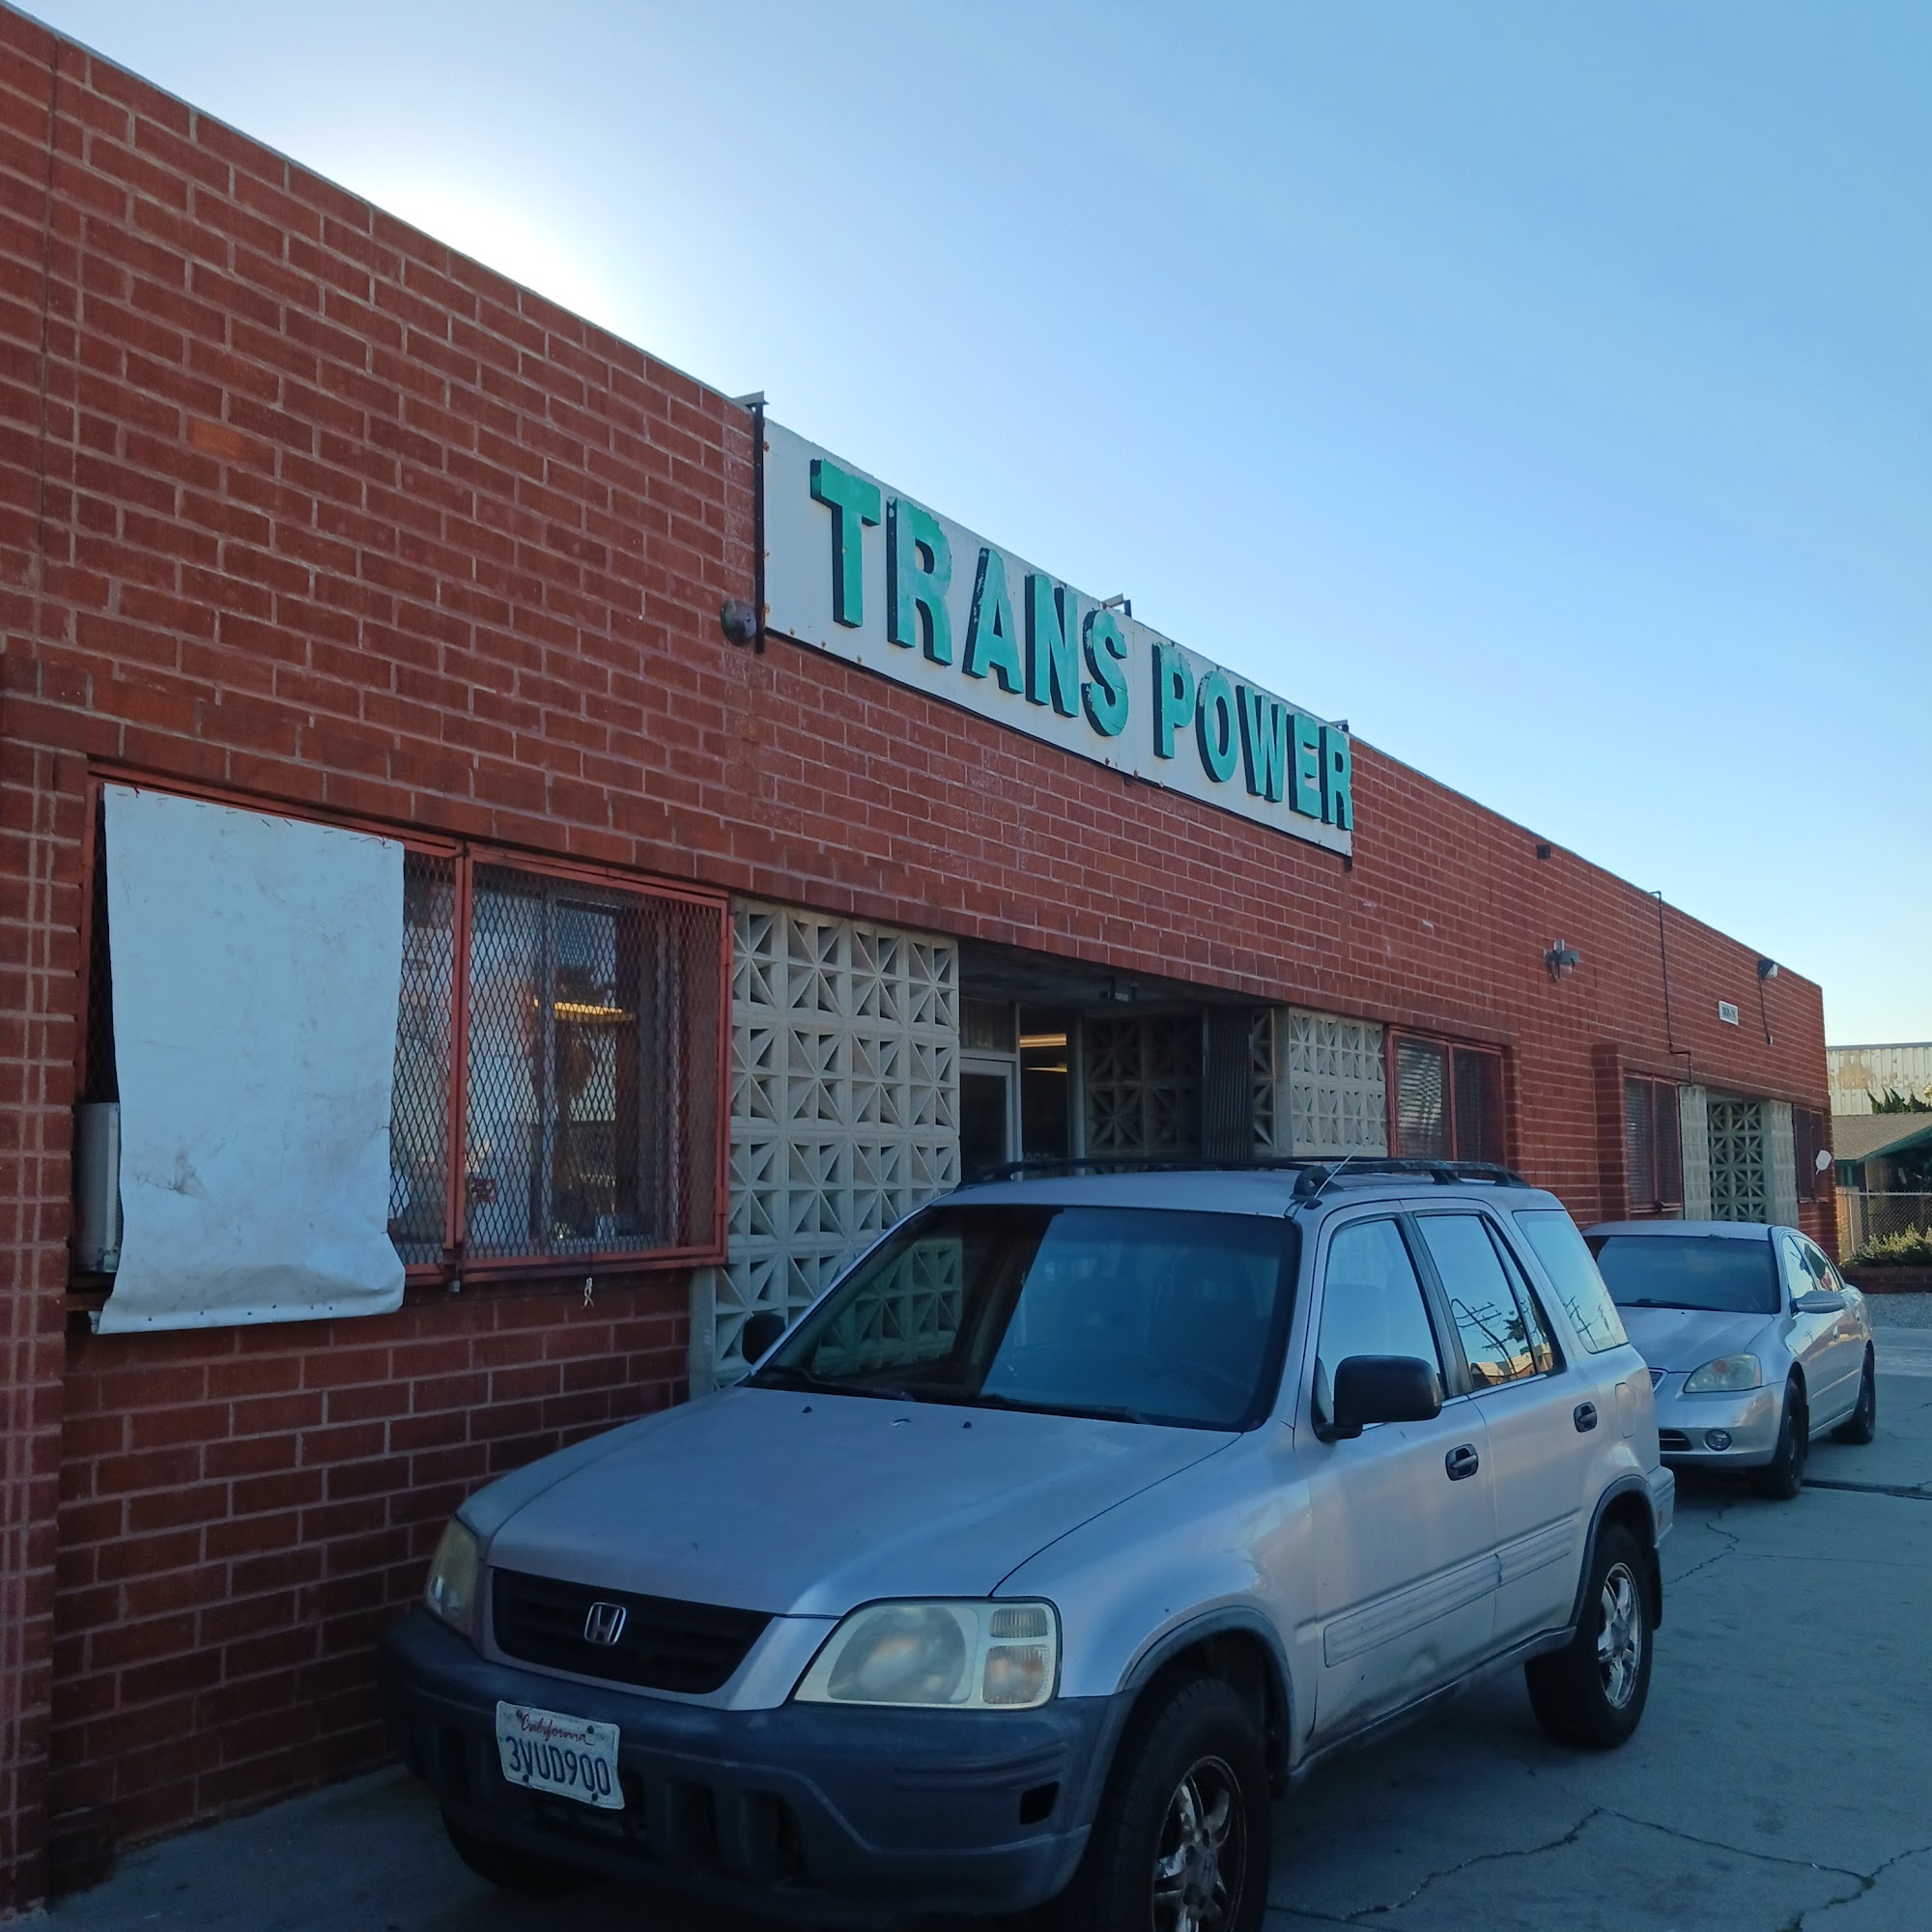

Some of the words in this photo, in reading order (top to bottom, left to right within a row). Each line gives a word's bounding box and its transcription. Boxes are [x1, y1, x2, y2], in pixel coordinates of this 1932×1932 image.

[810, 459, 1129, 737] TRANS
[1151, 640, 1354, 832] POWER
[521, 1713, 595, 1746] California
[505, 1735, 611, 1796] 3VUD900
